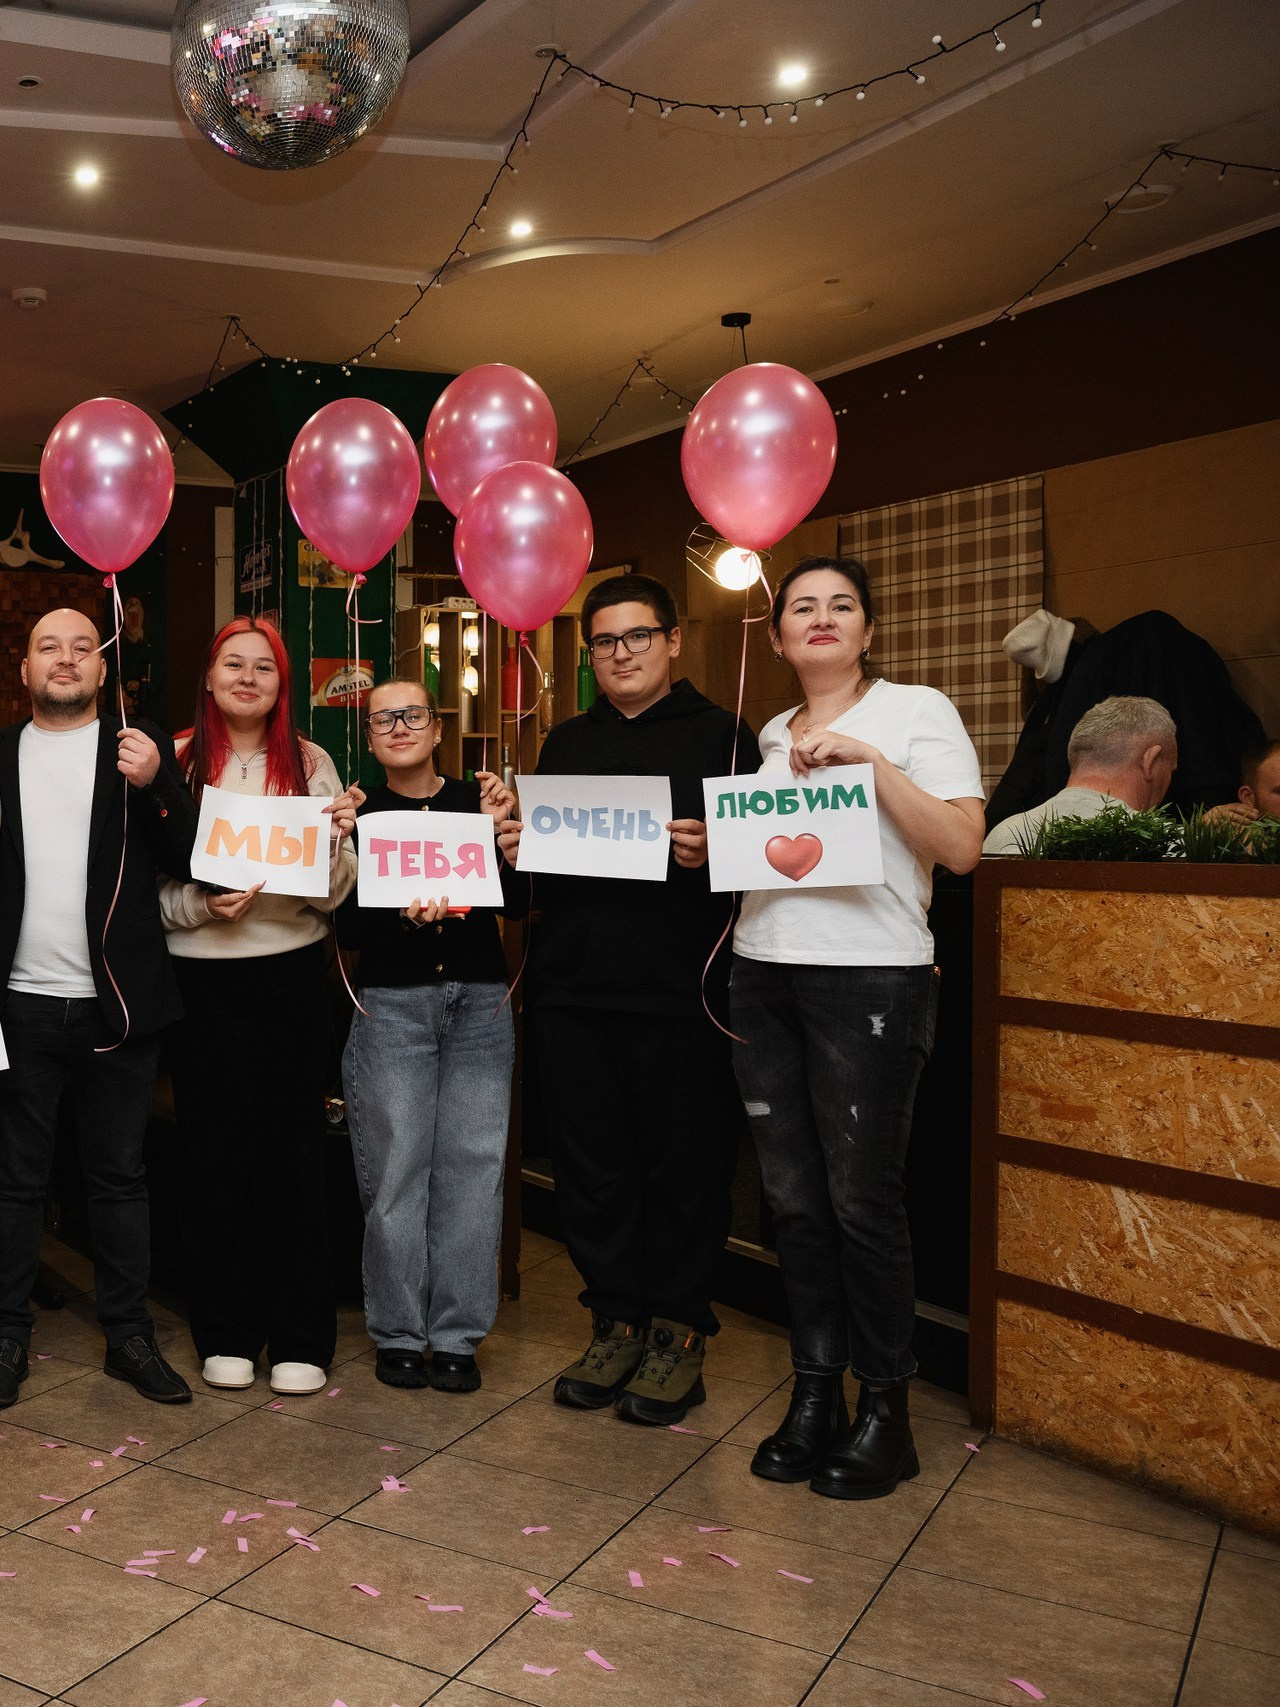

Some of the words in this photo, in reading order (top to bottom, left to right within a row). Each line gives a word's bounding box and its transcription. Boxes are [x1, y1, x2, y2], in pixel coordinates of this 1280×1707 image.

[331, 680, 370, 695] AMSTEL
[340, 690, 363, 702] BER
[715, 783, 870, 820] ЛЮБИМ
[531, 804, 661, 842] ОЧЕНЬ
[205, 817, 318, 867] МЫ
[370, 837, 487, 880] ТЕБЯ
